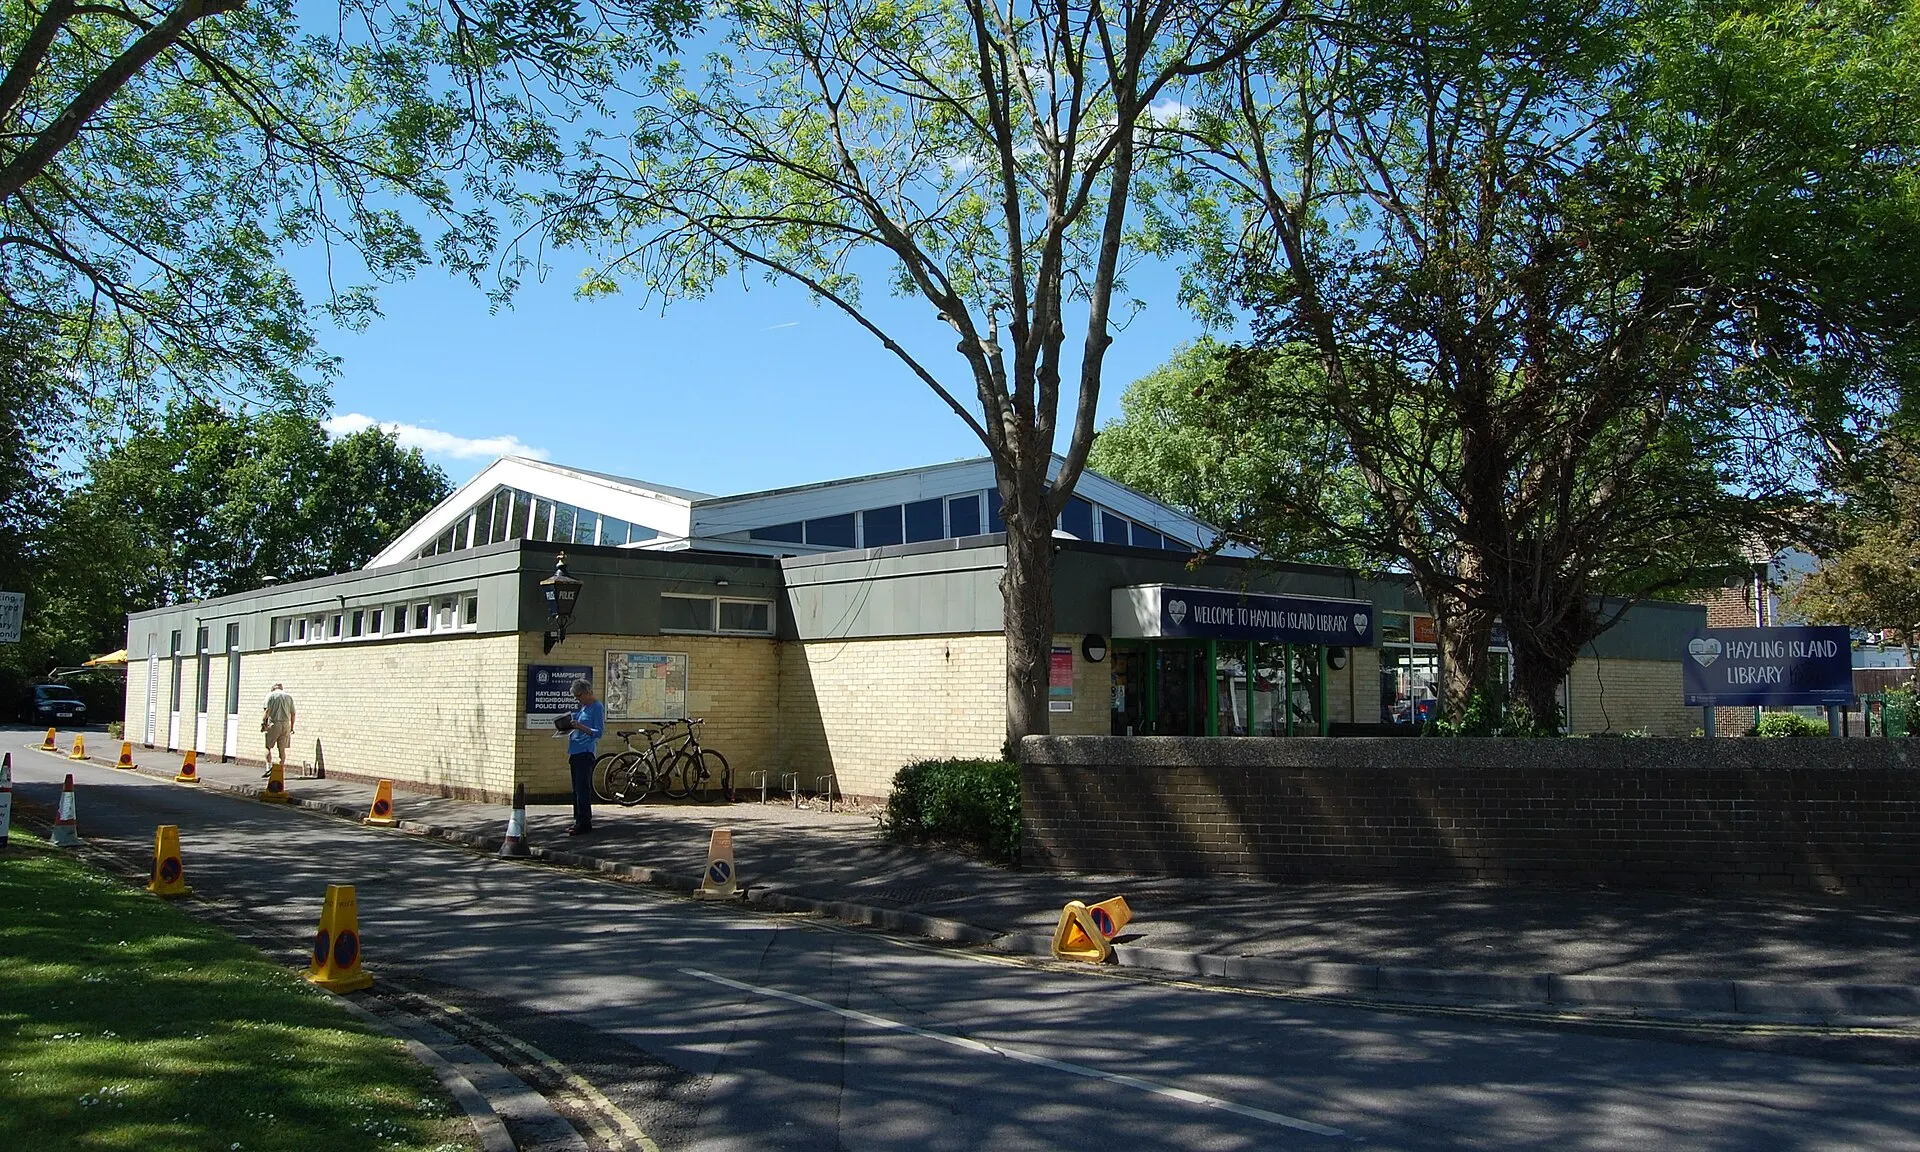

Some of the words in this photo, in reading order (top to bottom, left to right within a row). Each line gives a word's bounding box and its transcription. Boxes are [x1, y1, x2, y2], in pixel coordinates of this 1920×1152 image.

[559, 590, 575, 600] POLICE
[1194, 605, 1235, 626] WELCOME
[1238, 607, 1249, 626] TO
[1250, 609, 1285, 628] HAYLING
[1287, 612, 1315, 631] ISLAND
[1316, 613, 1349, 632] LIBRARY
[1726, 640, 1784, 659] HAYLING
[1788, 640, 1837, 658] ISLAND
[1727, 666, 1784, 684] LIBRARY
